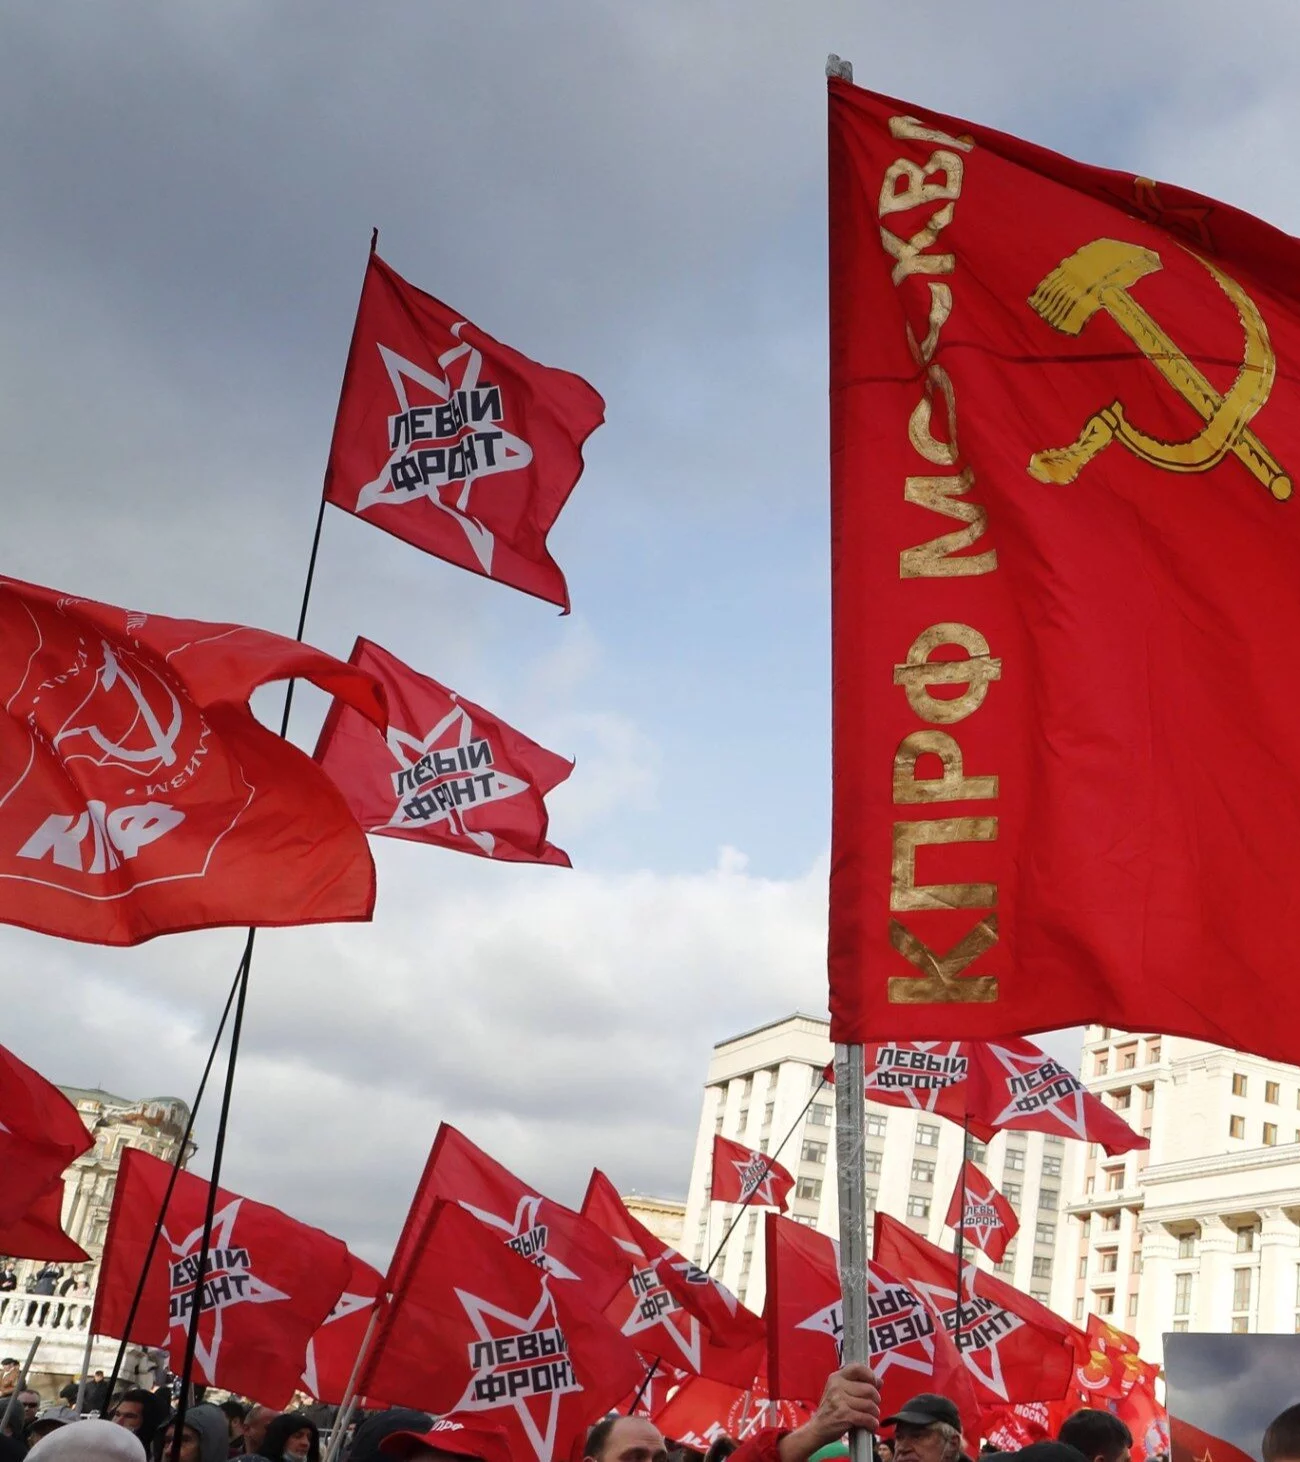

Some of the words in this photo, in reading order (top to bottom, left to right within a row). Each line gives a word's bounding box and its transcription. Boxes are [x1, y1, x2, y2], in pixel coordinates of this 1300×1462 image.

[888, 621, 1002, 1004] КПРФ
[876, 1048, 967, 1073] ЛЕВЫЙ
[876, 1071, 965, 1088] ФРОН
[966, 1205, 996, 1215] ЛЕВЫ
[472, 1328, 569, 1369] ЛЕВЫ
